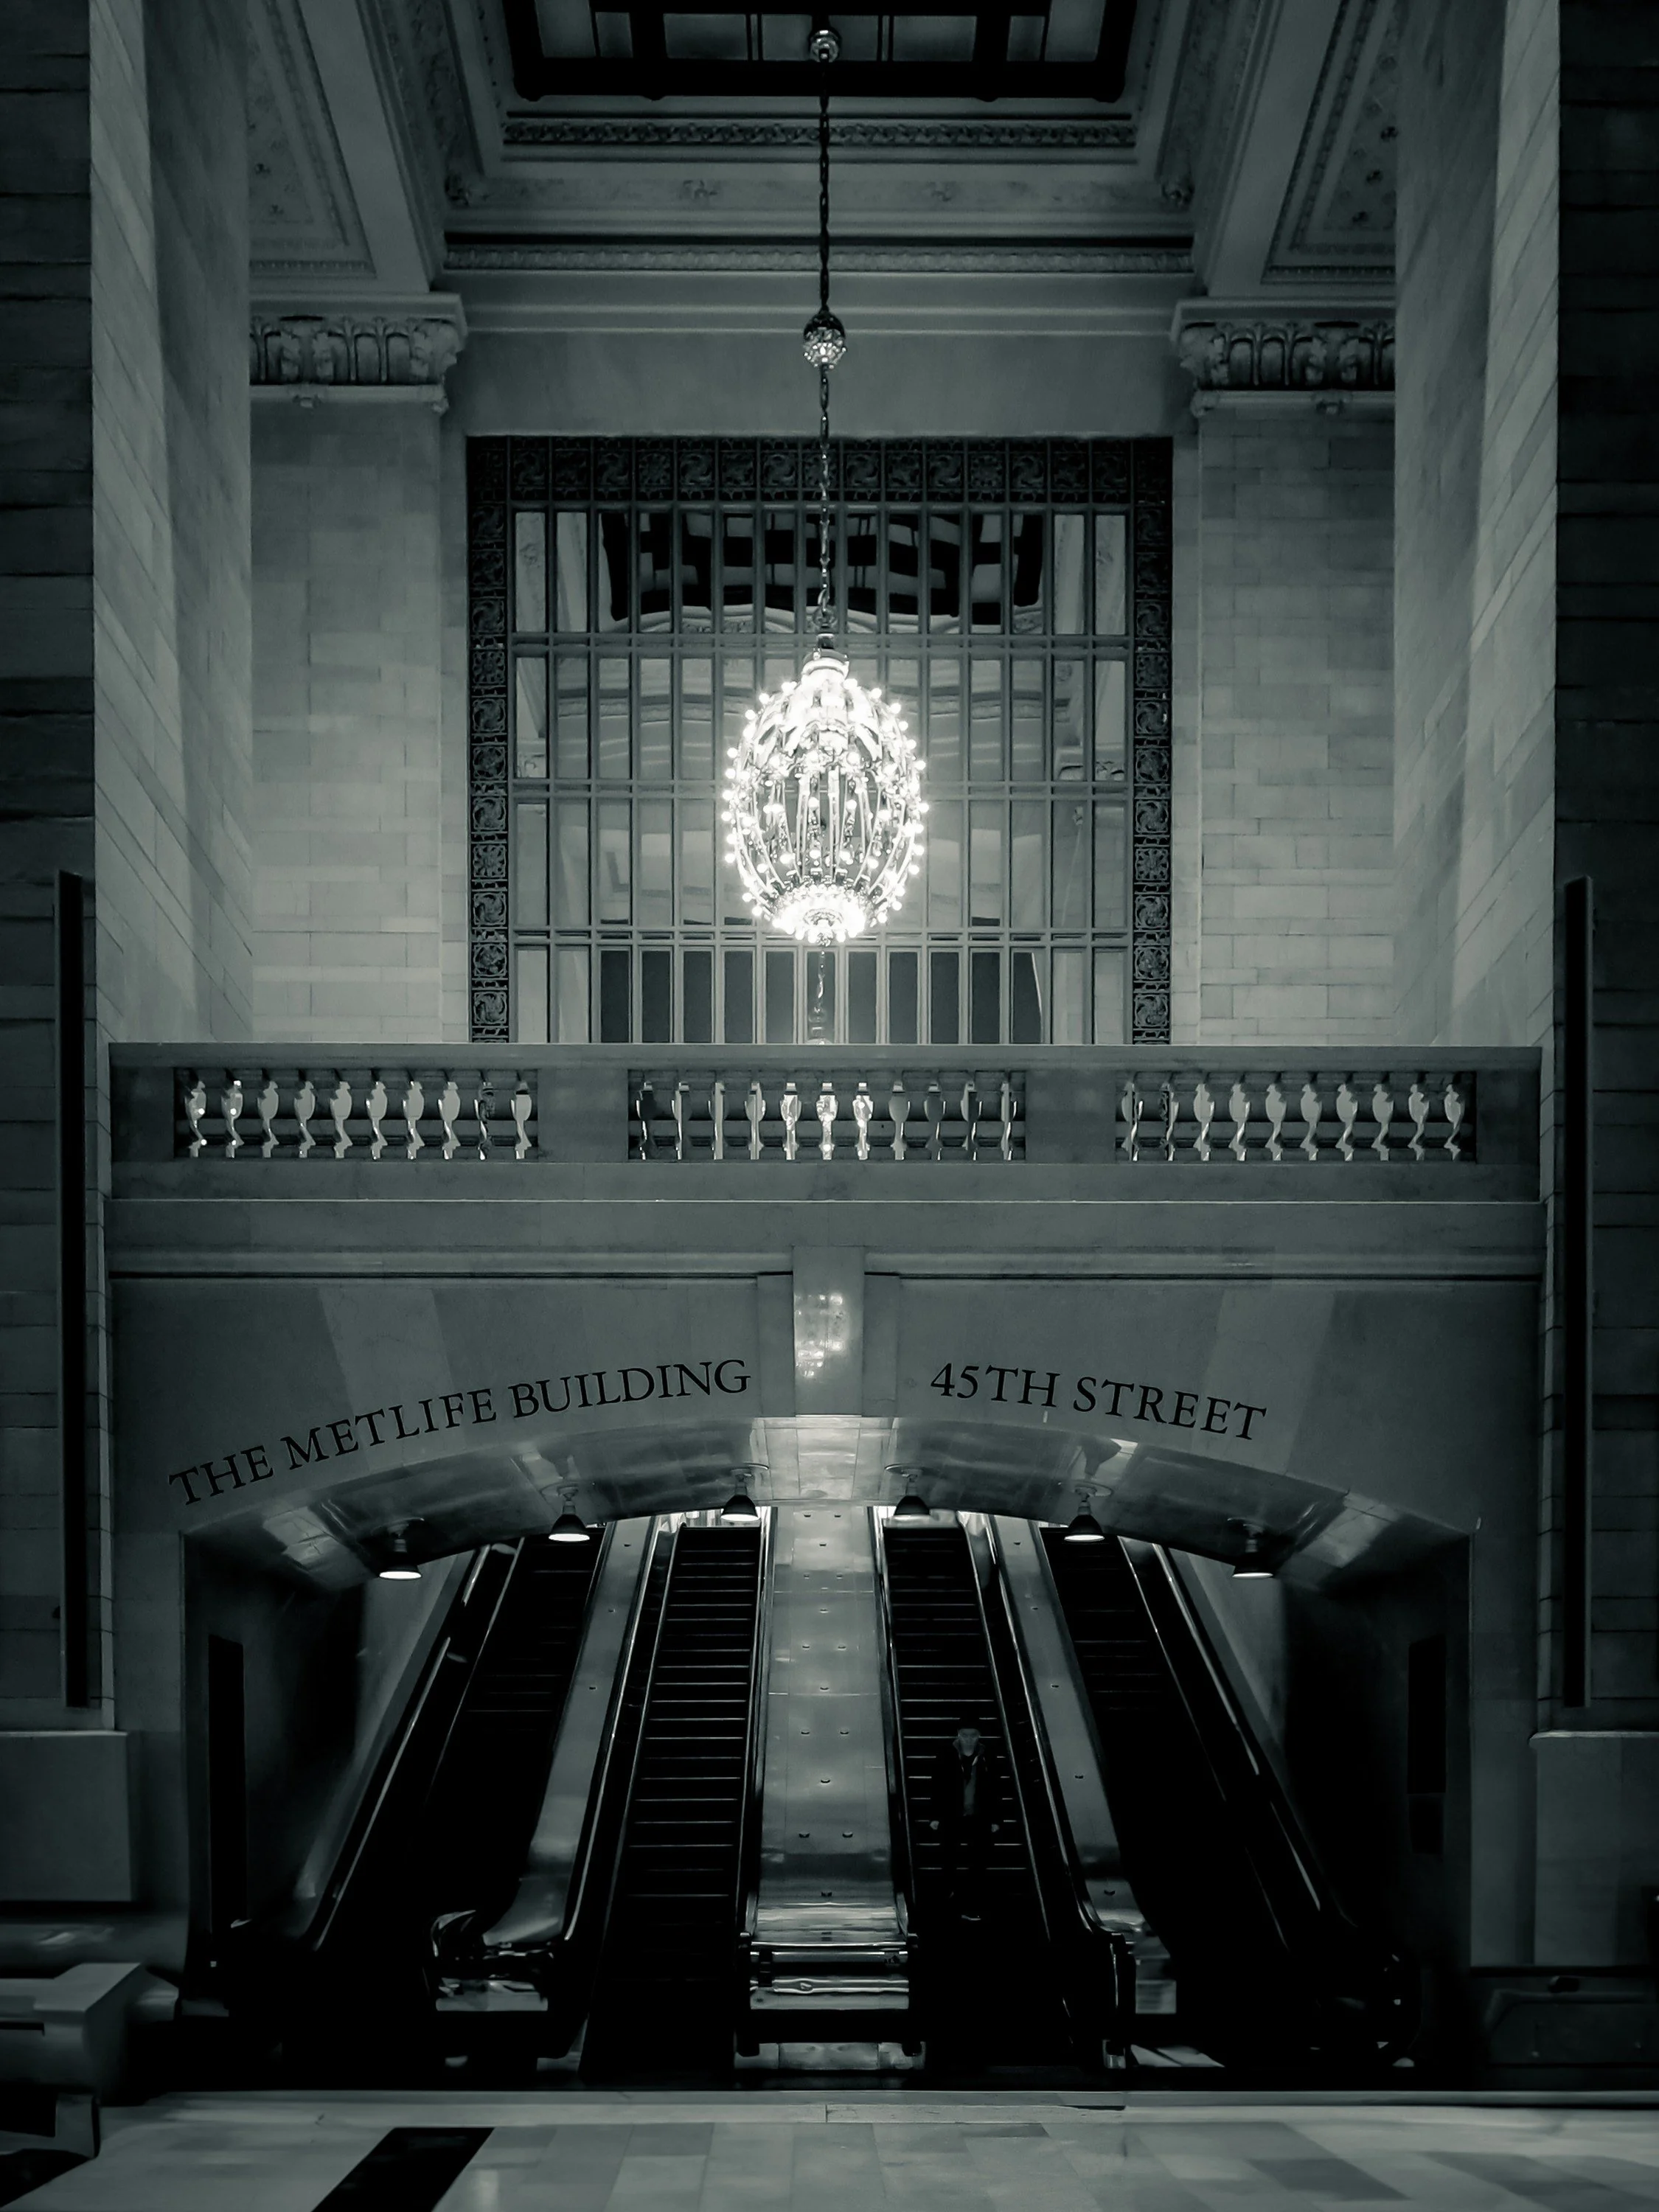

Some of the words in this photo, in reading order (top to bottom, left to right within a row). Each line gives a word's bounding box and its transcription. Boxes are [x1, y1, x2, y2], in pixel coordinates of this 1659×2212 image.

[169, 1445, 274, 1506] THE
[281, 1389, 498, 1470] METLIFE
[508, 1360, 751, 1418] BUILDING
[931, 1363, 1060, 1408] 45TH
[1073, 1377, 1267, 1440] STREET
